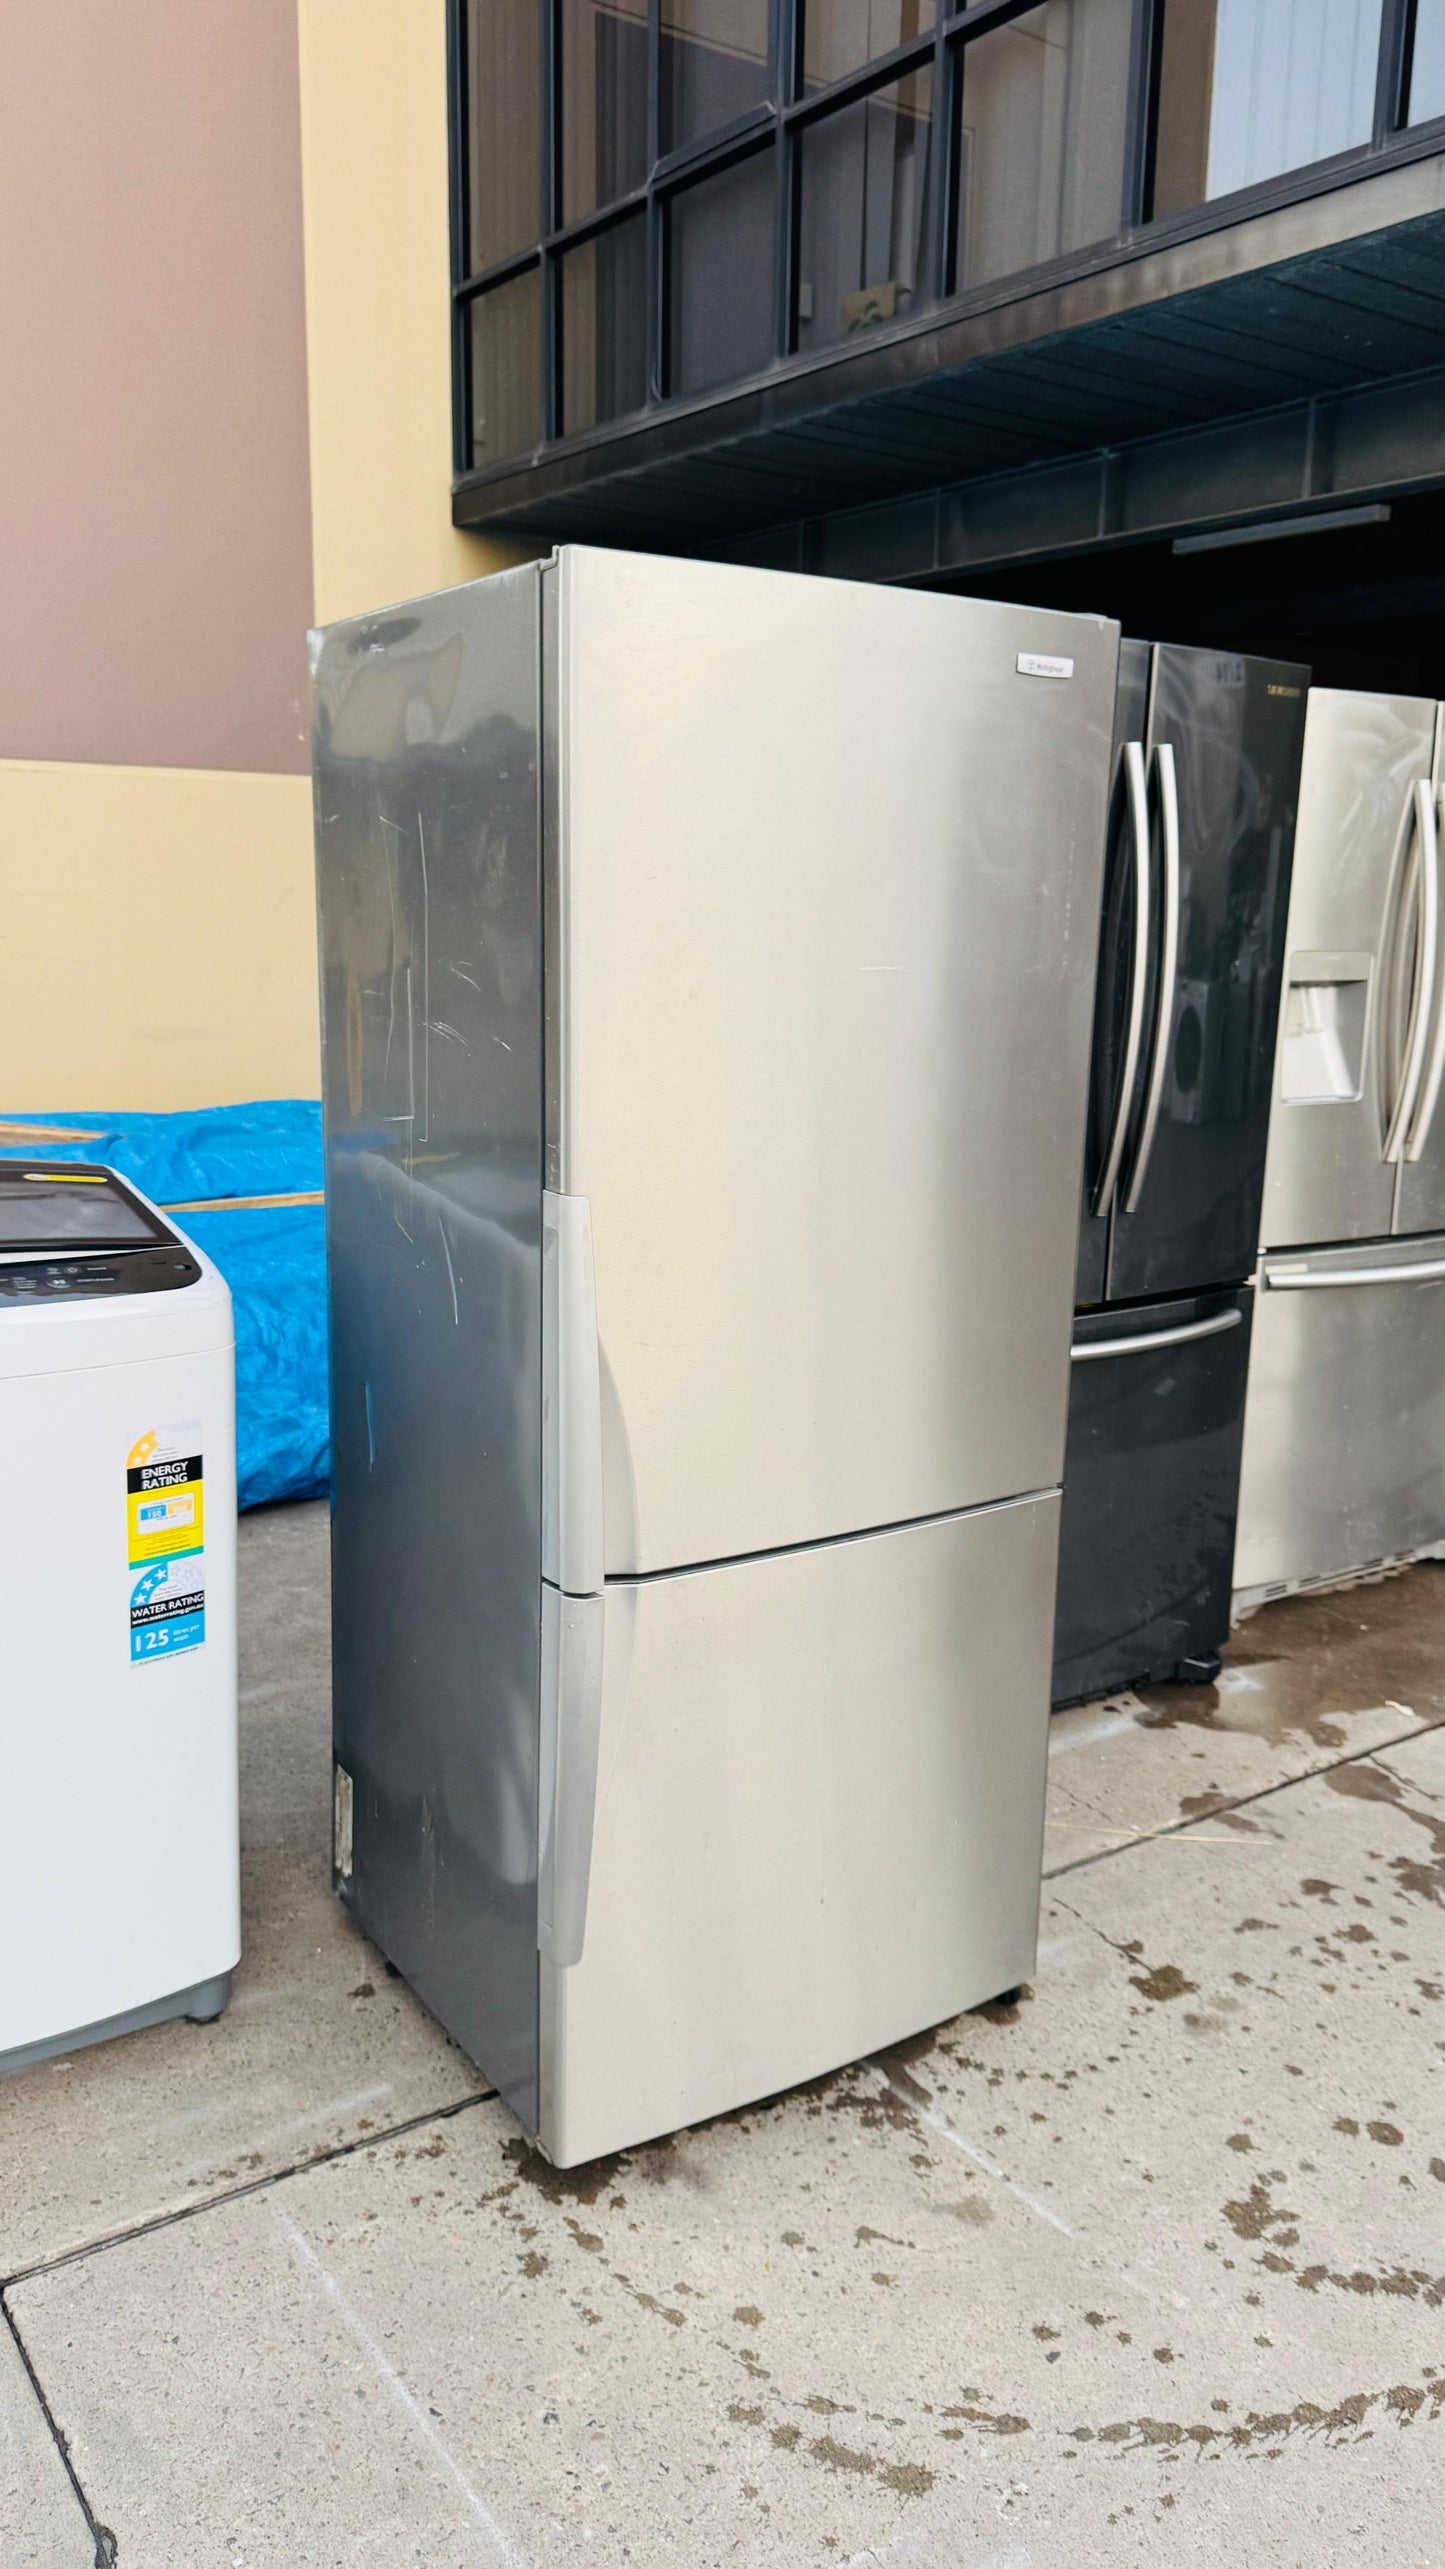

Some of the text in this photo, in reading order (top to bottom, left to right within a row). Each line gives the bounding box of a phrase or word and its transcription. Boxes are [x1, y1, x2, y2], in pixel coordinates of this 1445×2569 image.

[141, 1461, 188, 1480] ENERGY
[142, 1472, 188, 1490] RATING
[131, 1593, 204, 1618] WATER RATING
[135, 1628, 169, 1652] 125
